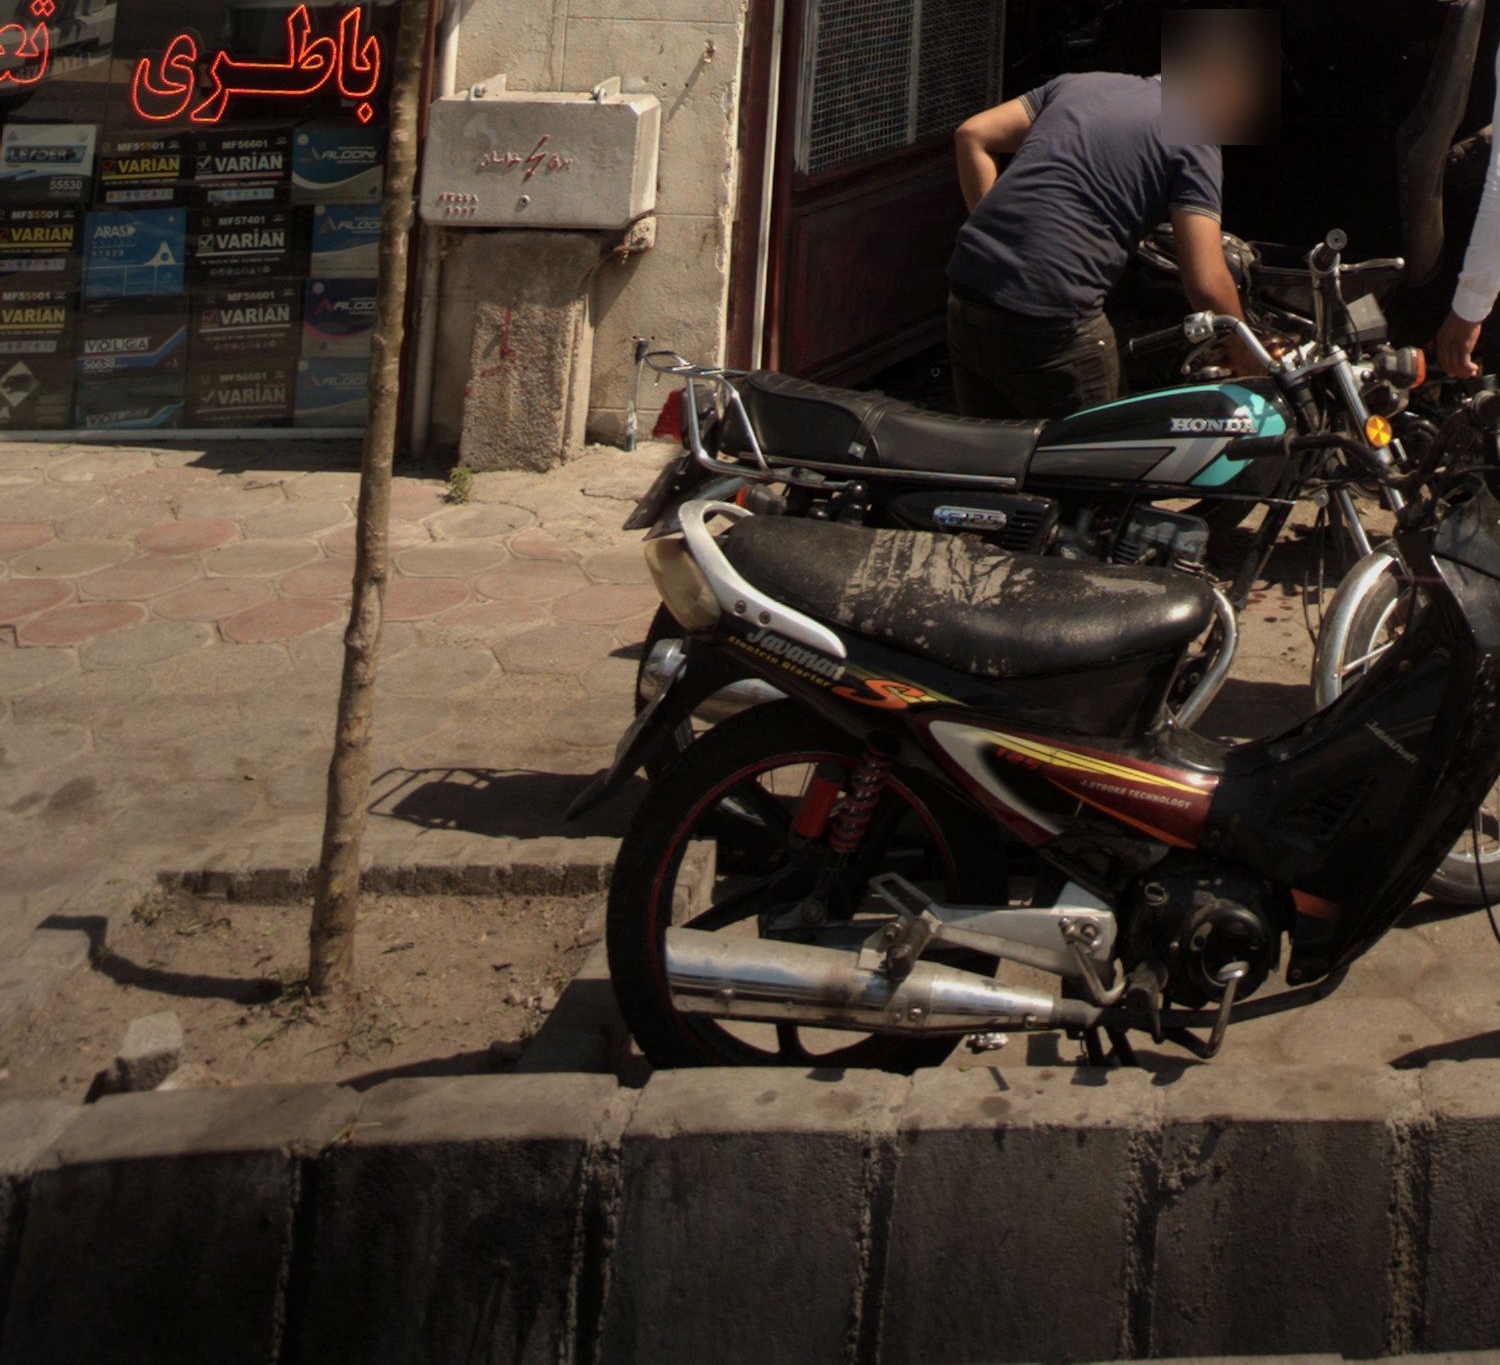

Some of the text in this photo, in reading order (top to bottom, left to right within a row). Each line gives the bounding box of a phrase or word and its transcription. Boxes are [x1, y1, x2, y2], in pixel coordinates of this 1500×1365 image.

[132, 4, 382, 125] باطری
[1170, 418, 1258, 433] HONDA
[1128, 788, 1192, 809] TECHNOLOGY
